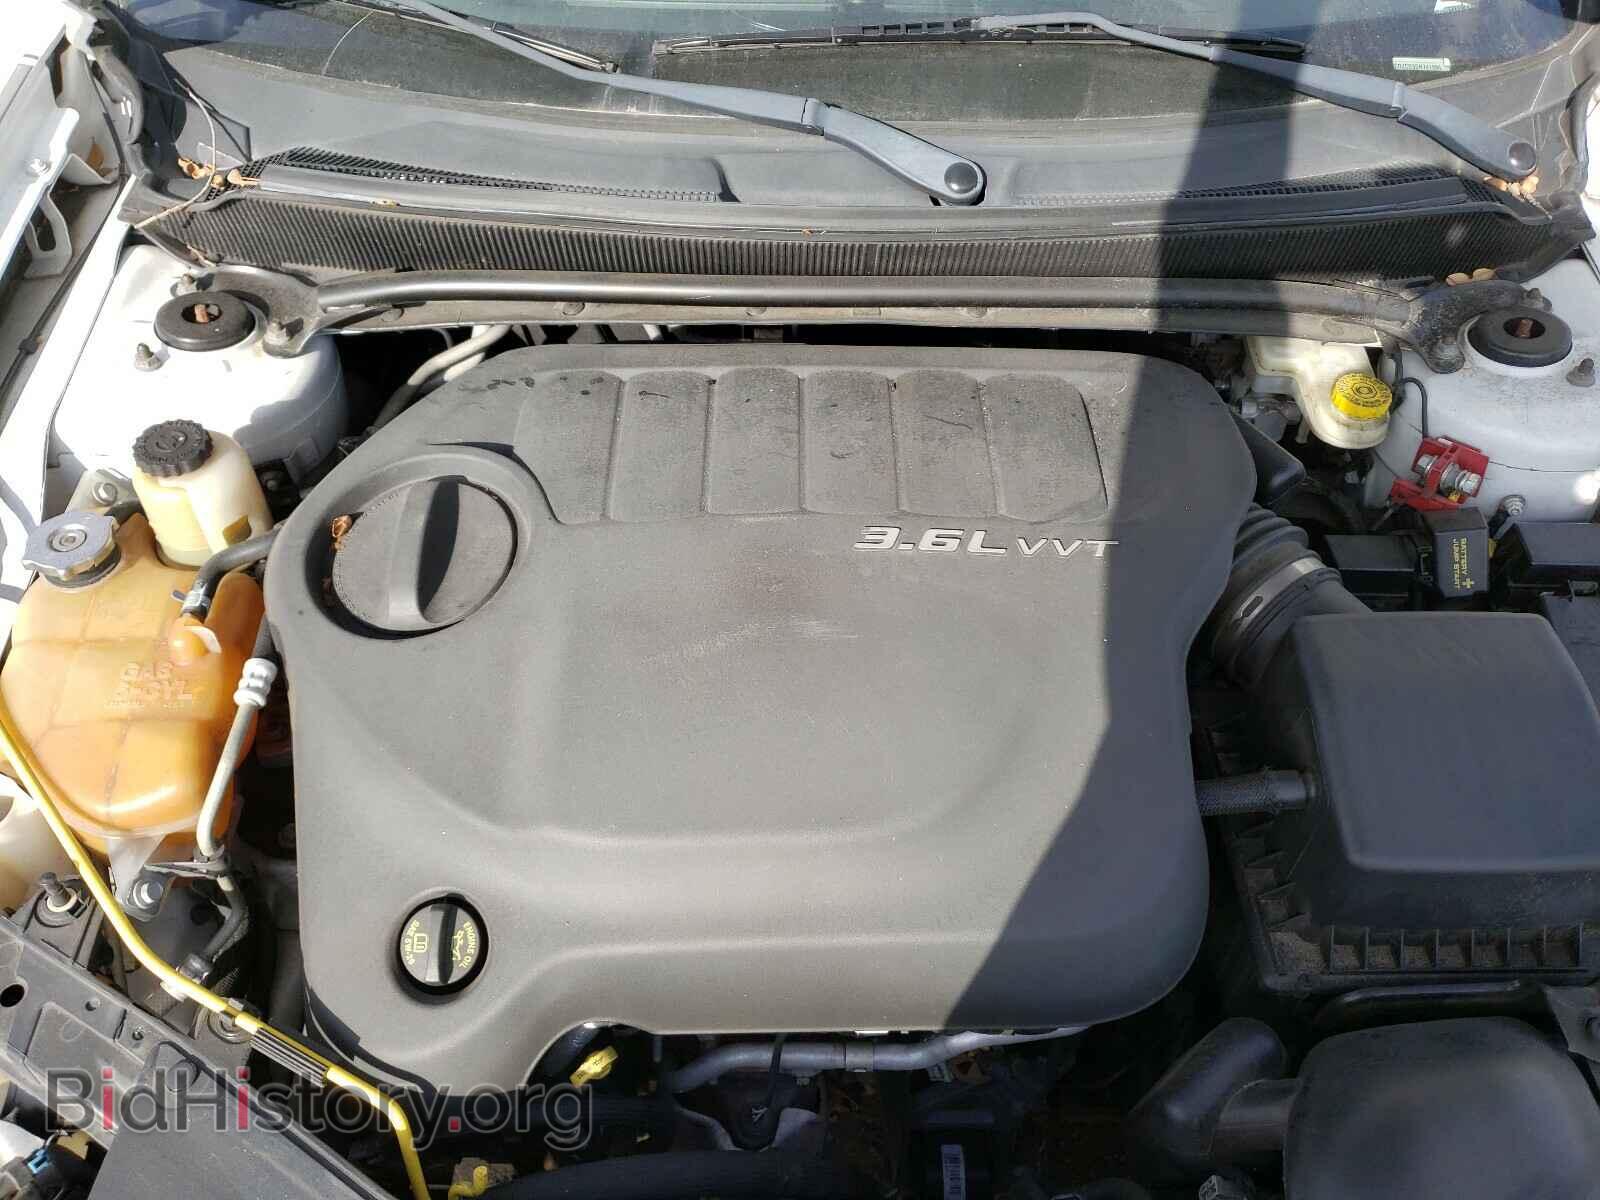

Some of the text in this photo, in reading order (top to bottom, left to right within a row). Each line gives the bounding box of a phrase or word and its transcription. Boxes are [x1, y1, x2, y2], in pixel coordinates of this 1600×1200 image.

[853, 525, 1120, 558] 3.6L VVT
[1460, 538, 1468, 575] BATTERY
[459, 922, 476, 968] ENGINE OIL
